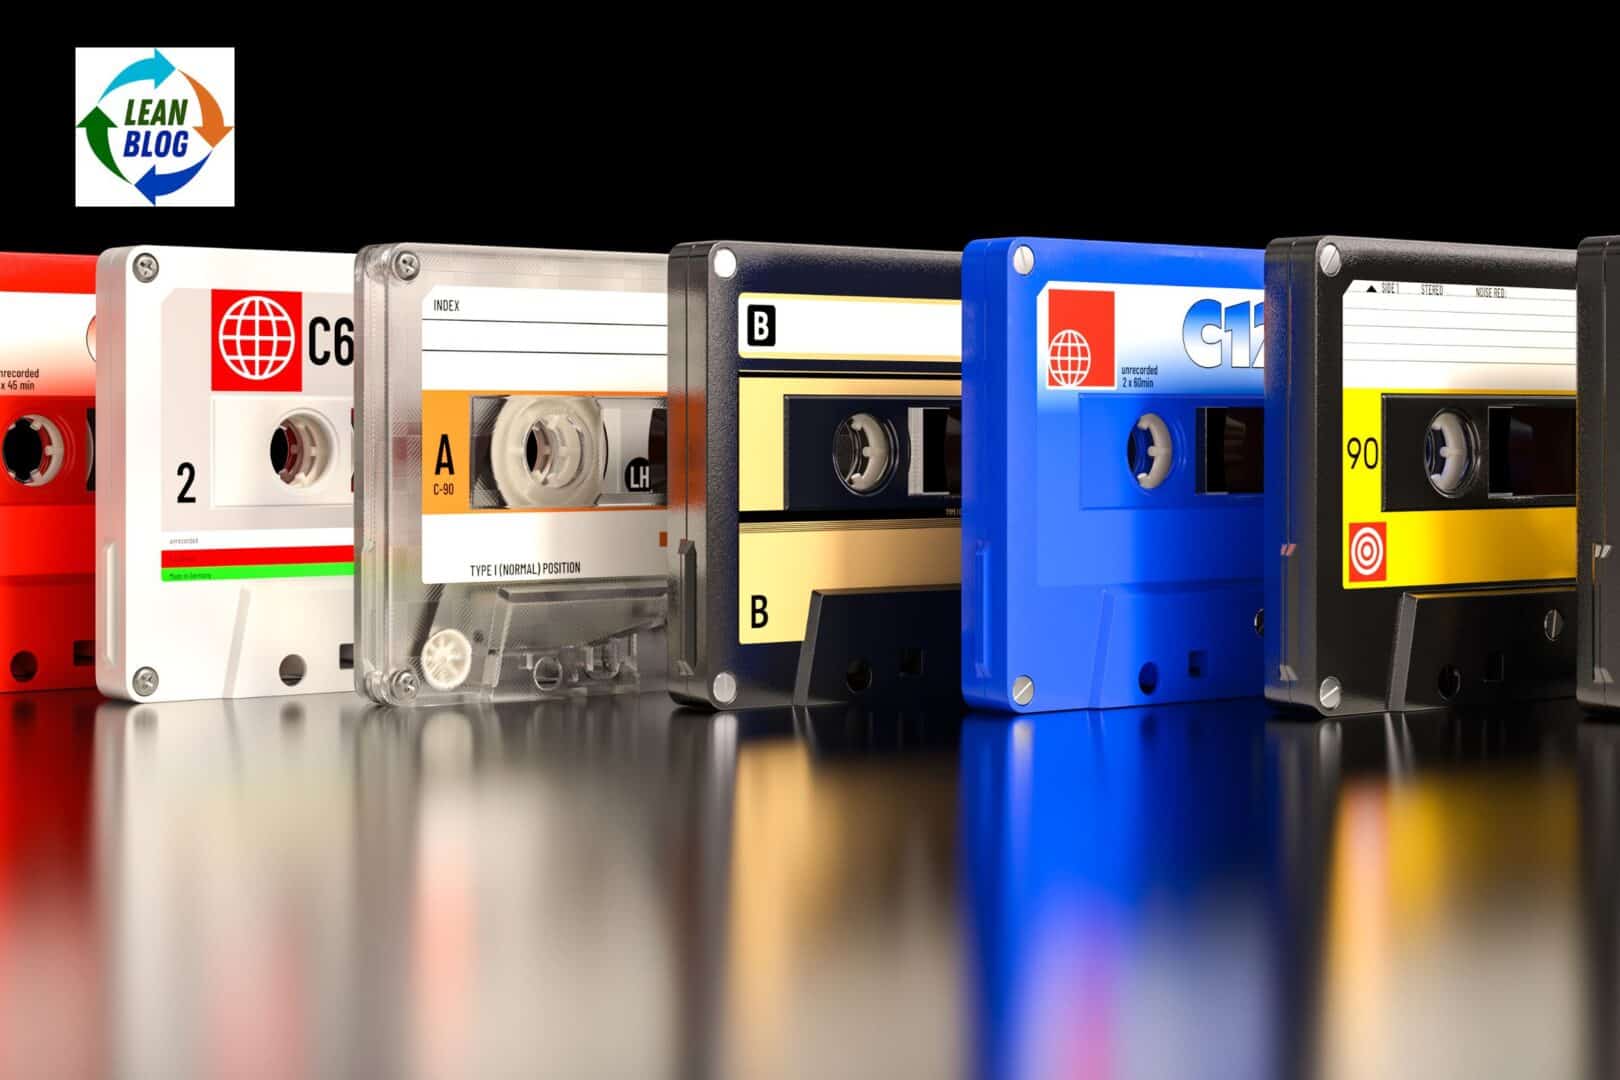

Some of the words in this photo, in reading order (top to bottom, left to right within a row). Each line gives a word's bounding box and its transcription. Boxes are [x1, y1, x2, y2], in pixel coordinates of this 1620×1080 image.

[1421, 283, 1444, 296] STEREO
[1475, 287, 1492, 298] NOISE
[433, 299, 460, 312] INDEX
[753, 310, 770, 341] B
[309, 316, 354, 366] C6
[1121, 364, 1158, 375] unrecorded
[8, 380, 17, 390] 45
[20, 379, 35, 390] min
[1122, 377, 1127, 388] 2
[434, 433, 455, 475] A
[1347, 437, 1379, 470] 90
[177, 462, 196, 503] 2
[630, 466, 650, 488] LH
[433, 483, 454, 496] C-90
[470, 564, 493, 577] TYPE
[499, 562, 541, 577] (NORMAL)
[543, 561, 581, 575] POSITION
[751, 595, 769, 629] B
